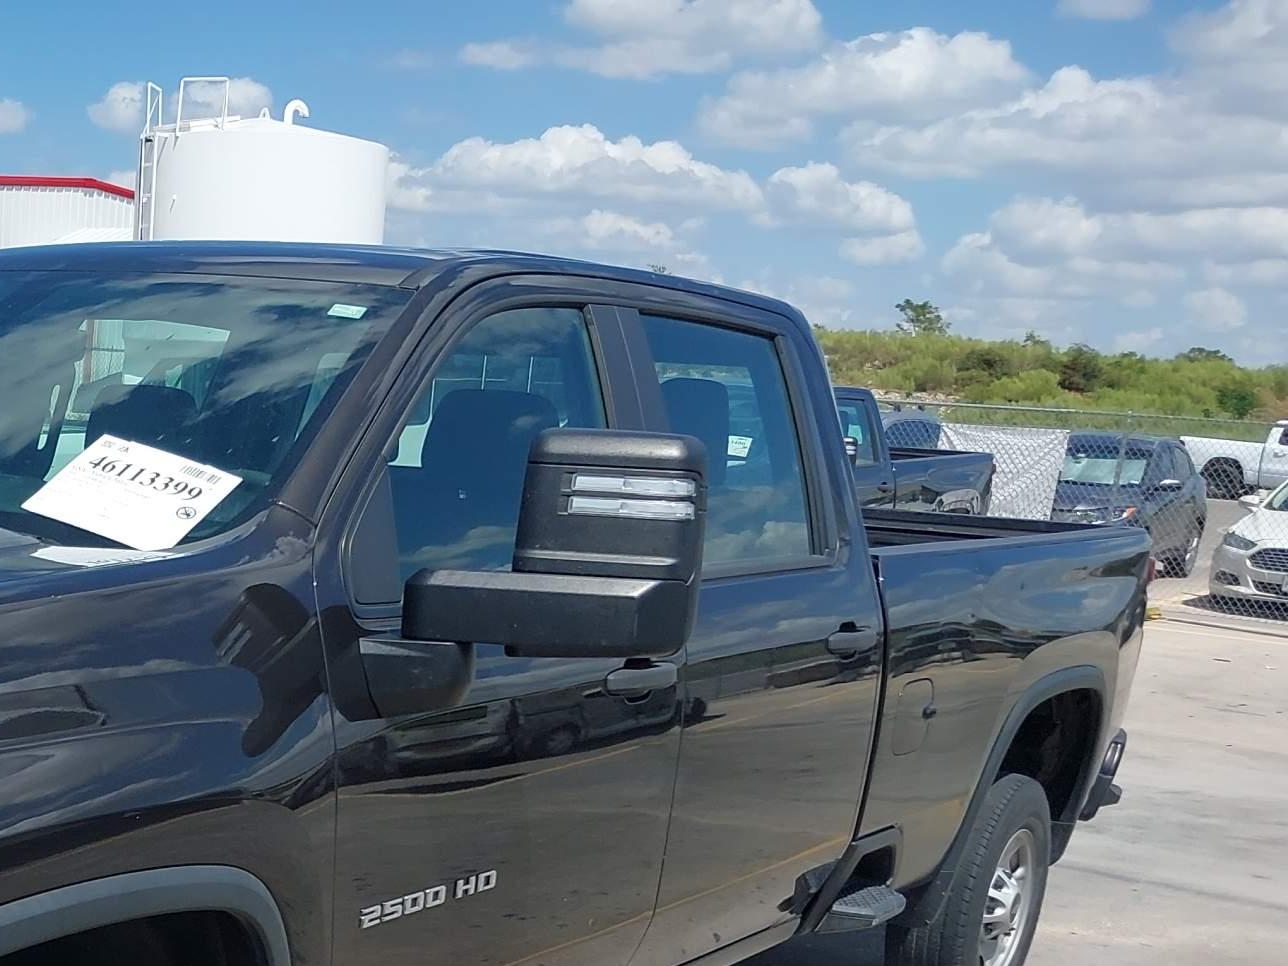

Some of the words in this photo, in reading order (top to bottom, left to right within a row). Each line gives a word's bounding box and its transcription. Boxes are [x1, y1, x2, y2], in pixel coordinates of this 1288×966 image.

[89, 456, 203, 501] 46113399
[360, 885, 447, 929] 2500
[454, 869, 498, 899] HD
